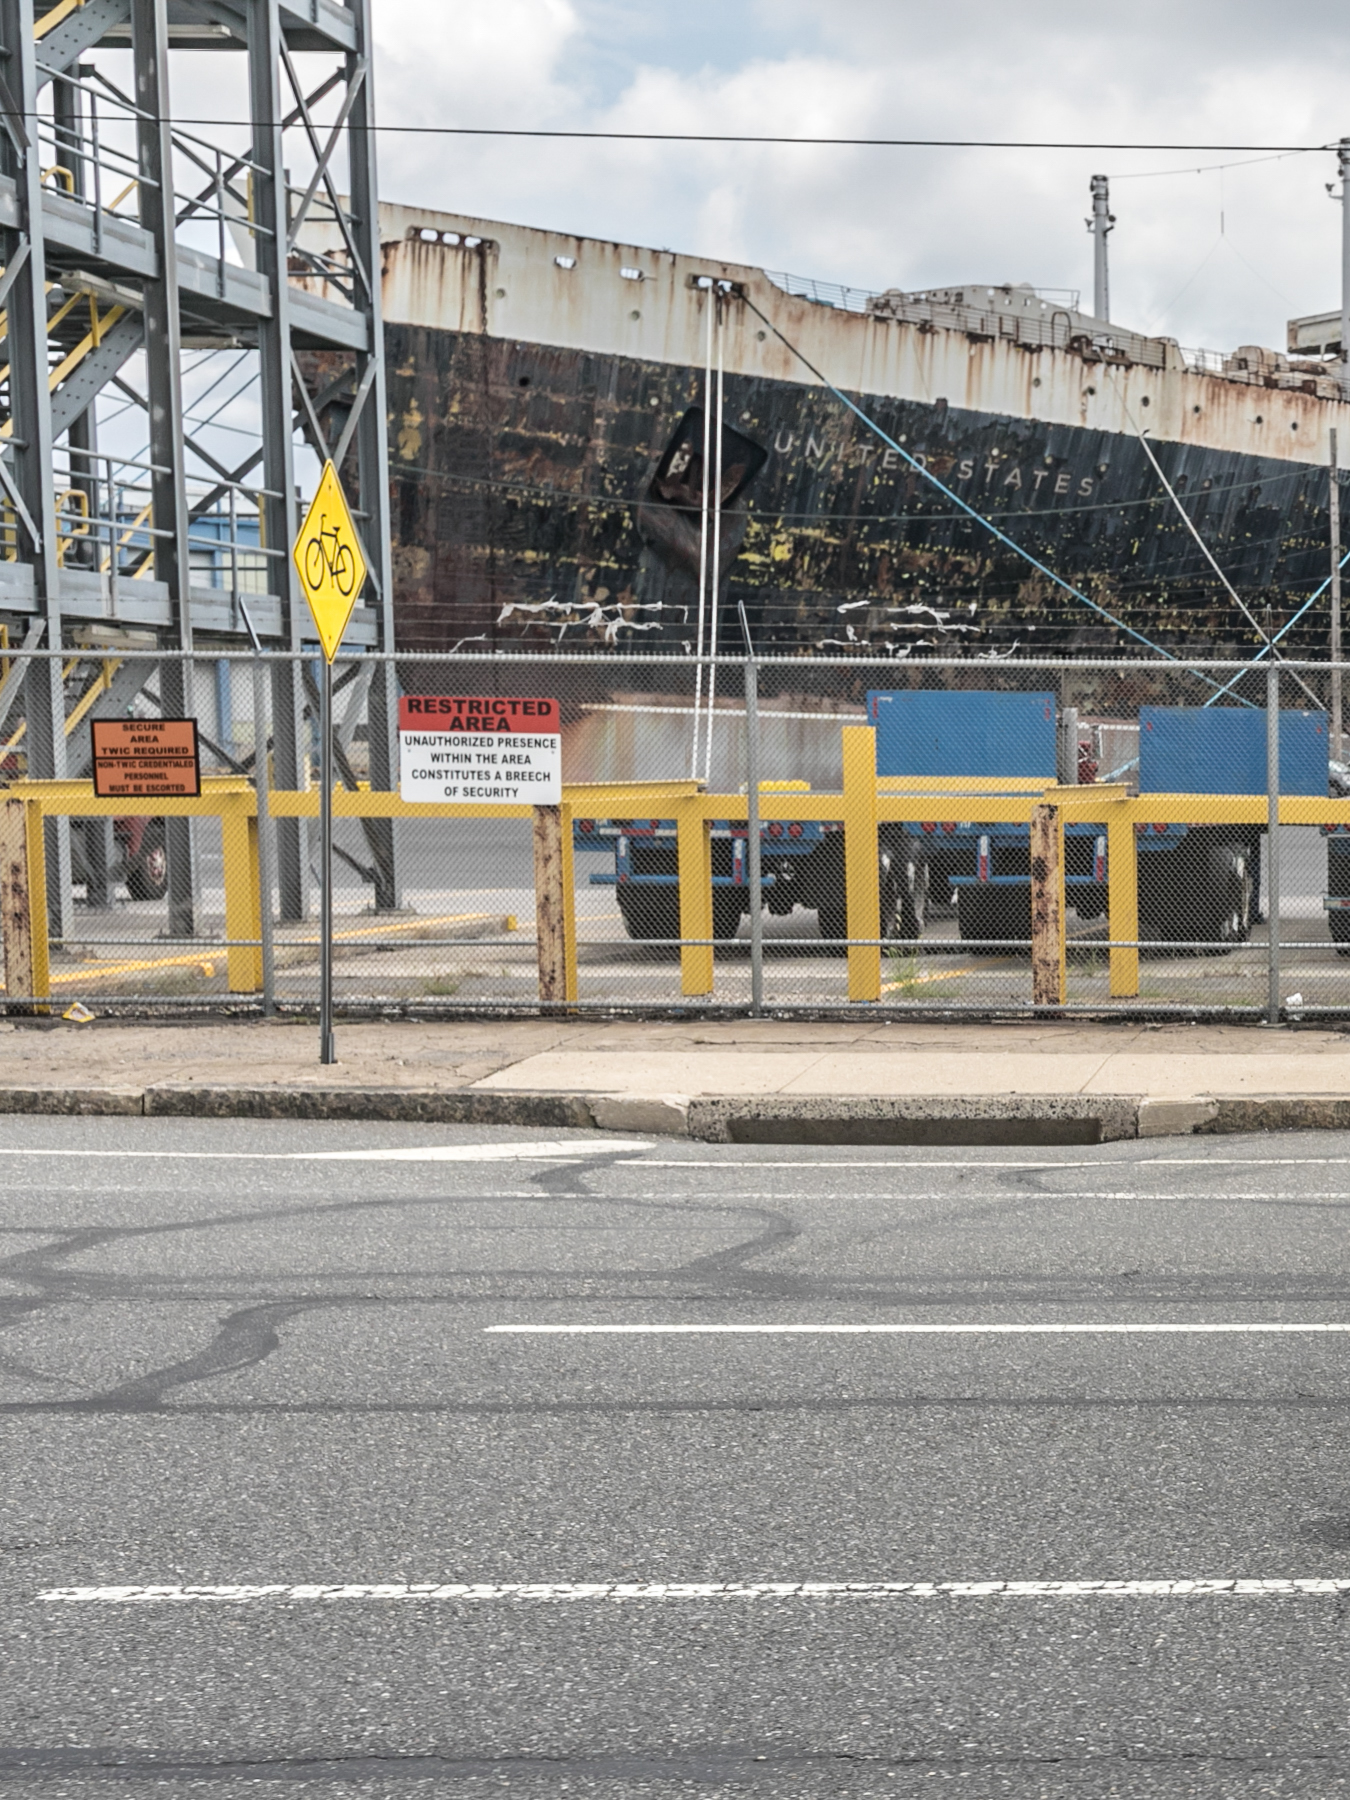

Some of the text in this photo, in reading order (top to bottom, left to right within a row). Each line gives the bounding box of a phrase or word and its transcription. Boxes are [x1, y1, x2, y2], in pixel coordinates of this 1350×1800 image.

[774, 430, 1095, 497] UNITED STATES
[407, 698, 552, 716] RESTRICTED
[122, 723, 165, 731] SECURE
[449, 716, 511, 732] AREA
[130, 735, 159, 743] AREA
[404, 735, 557, 749] UNAUTHORIZED PRESENCE
[101, 747, 189, 755] TWIC REQUIRED
[97, 760, 194, 768] NON-TWIC CREDENTIALED
[430, 752, 532, 765] WITHIN THE AREA
[124, 772, 169, 780] PERSONNEL
[411, 769, 551, 782] CONSTITUTES A BREECH
[109, 784, 186, 792] MUST BE ESCORTED
[444, 786, 519, 798] OF SECURITY
